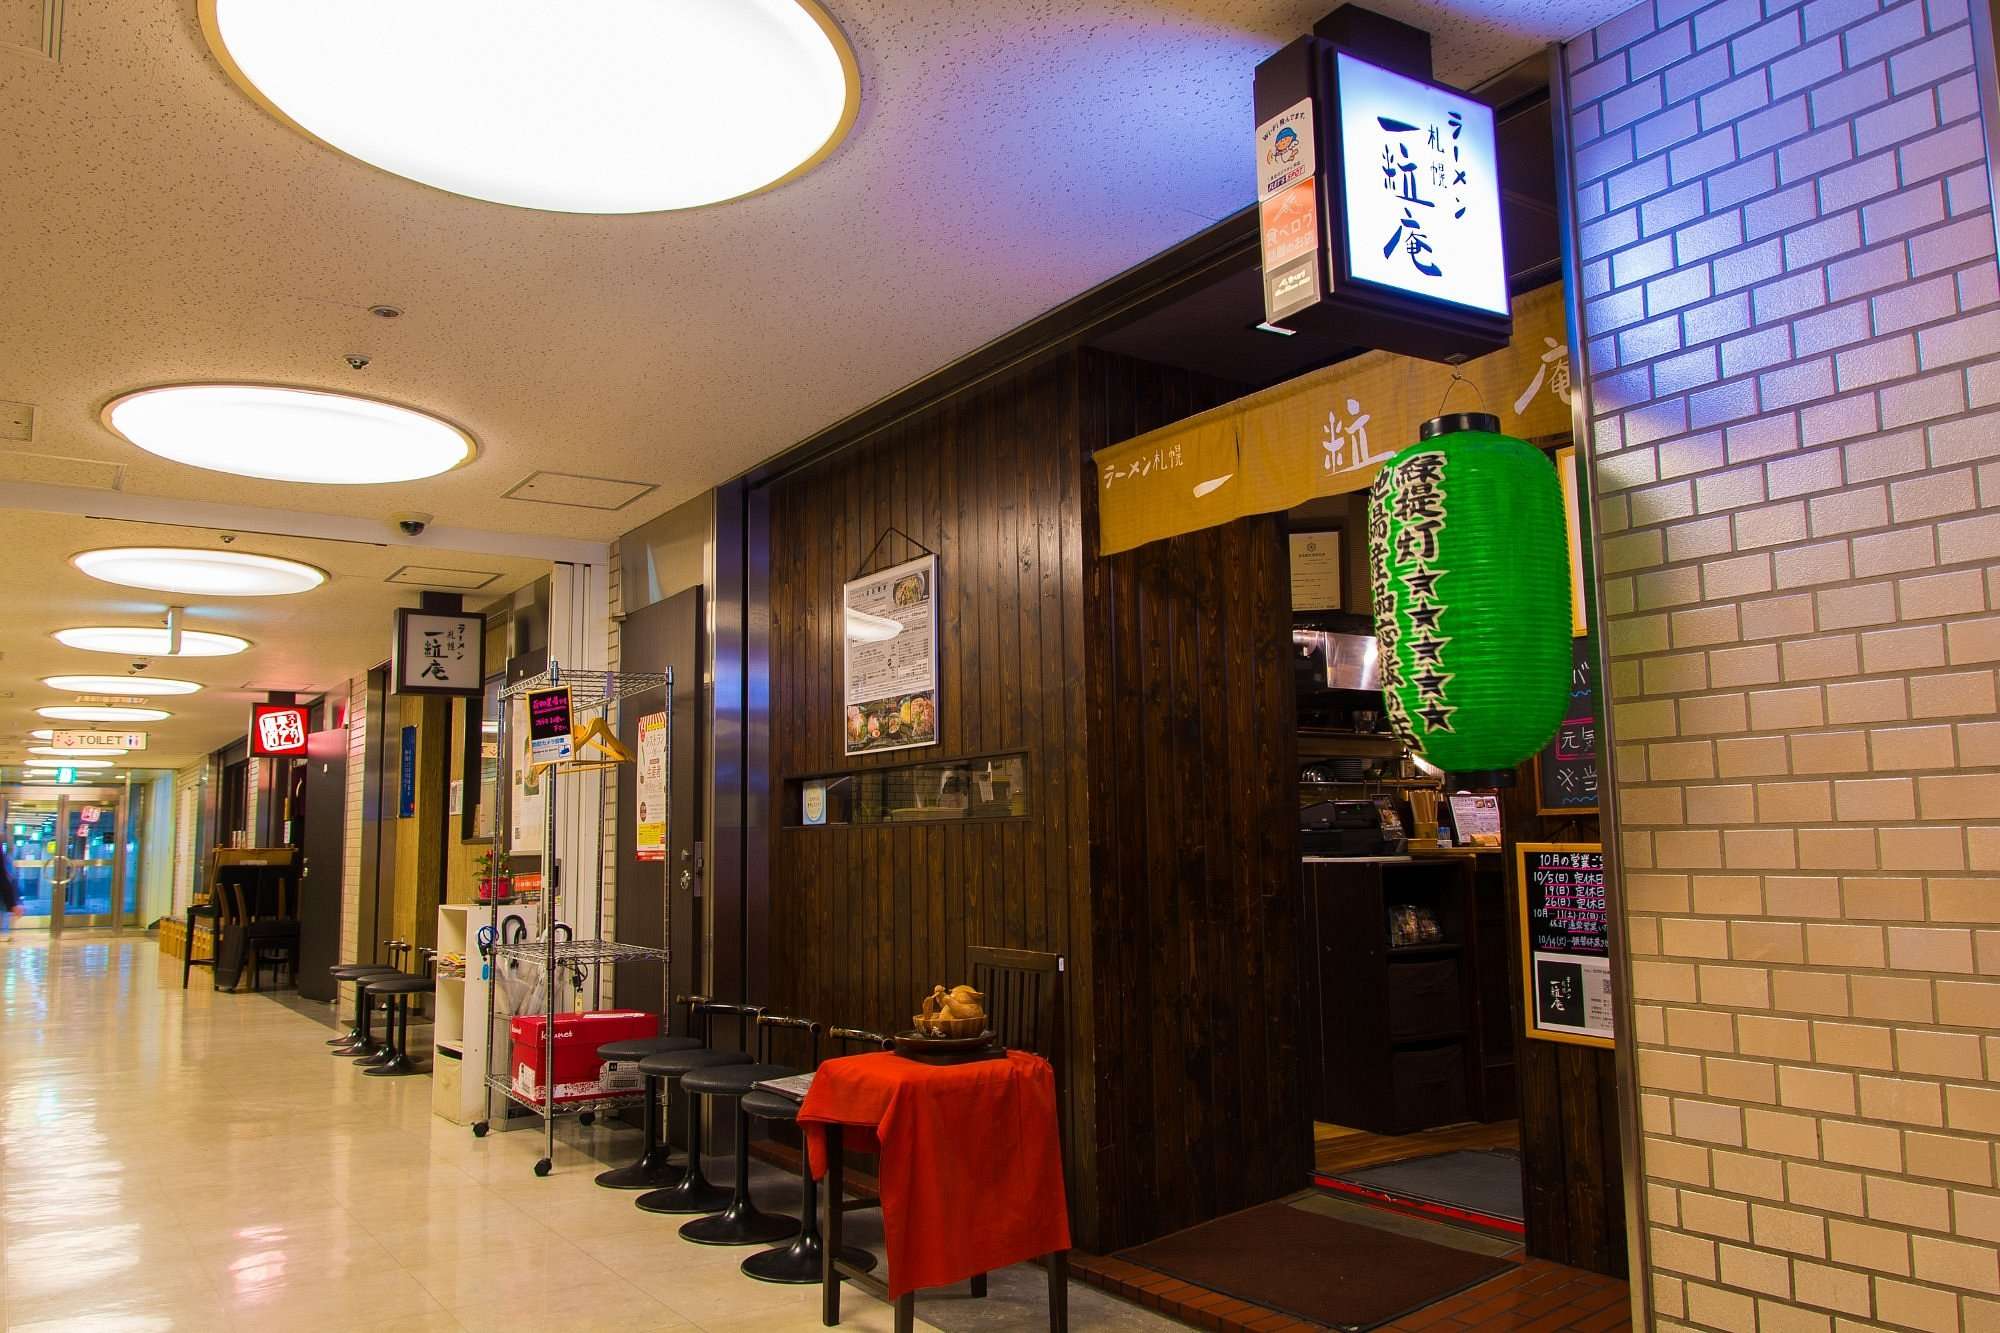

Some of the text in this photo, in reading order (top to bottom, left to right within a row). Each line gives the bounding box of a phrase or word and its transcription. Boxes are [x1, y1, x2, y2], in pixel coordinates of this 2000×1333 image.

[1427, 123, 1448, 190] 札幌
[1447, 110, 1467, 220] ラーメン
[1376, 114, 1443, 278] 一粒庵
[420, 631, 450, 681] 一粒庵
[78, 735, 123, 745] TOILET
[1533, 871, 1604, 885] 10/5(日) 定休日
[1575, 886, 1605, 898] 定休日
[1577, 898, 1606, 910] 定休日
